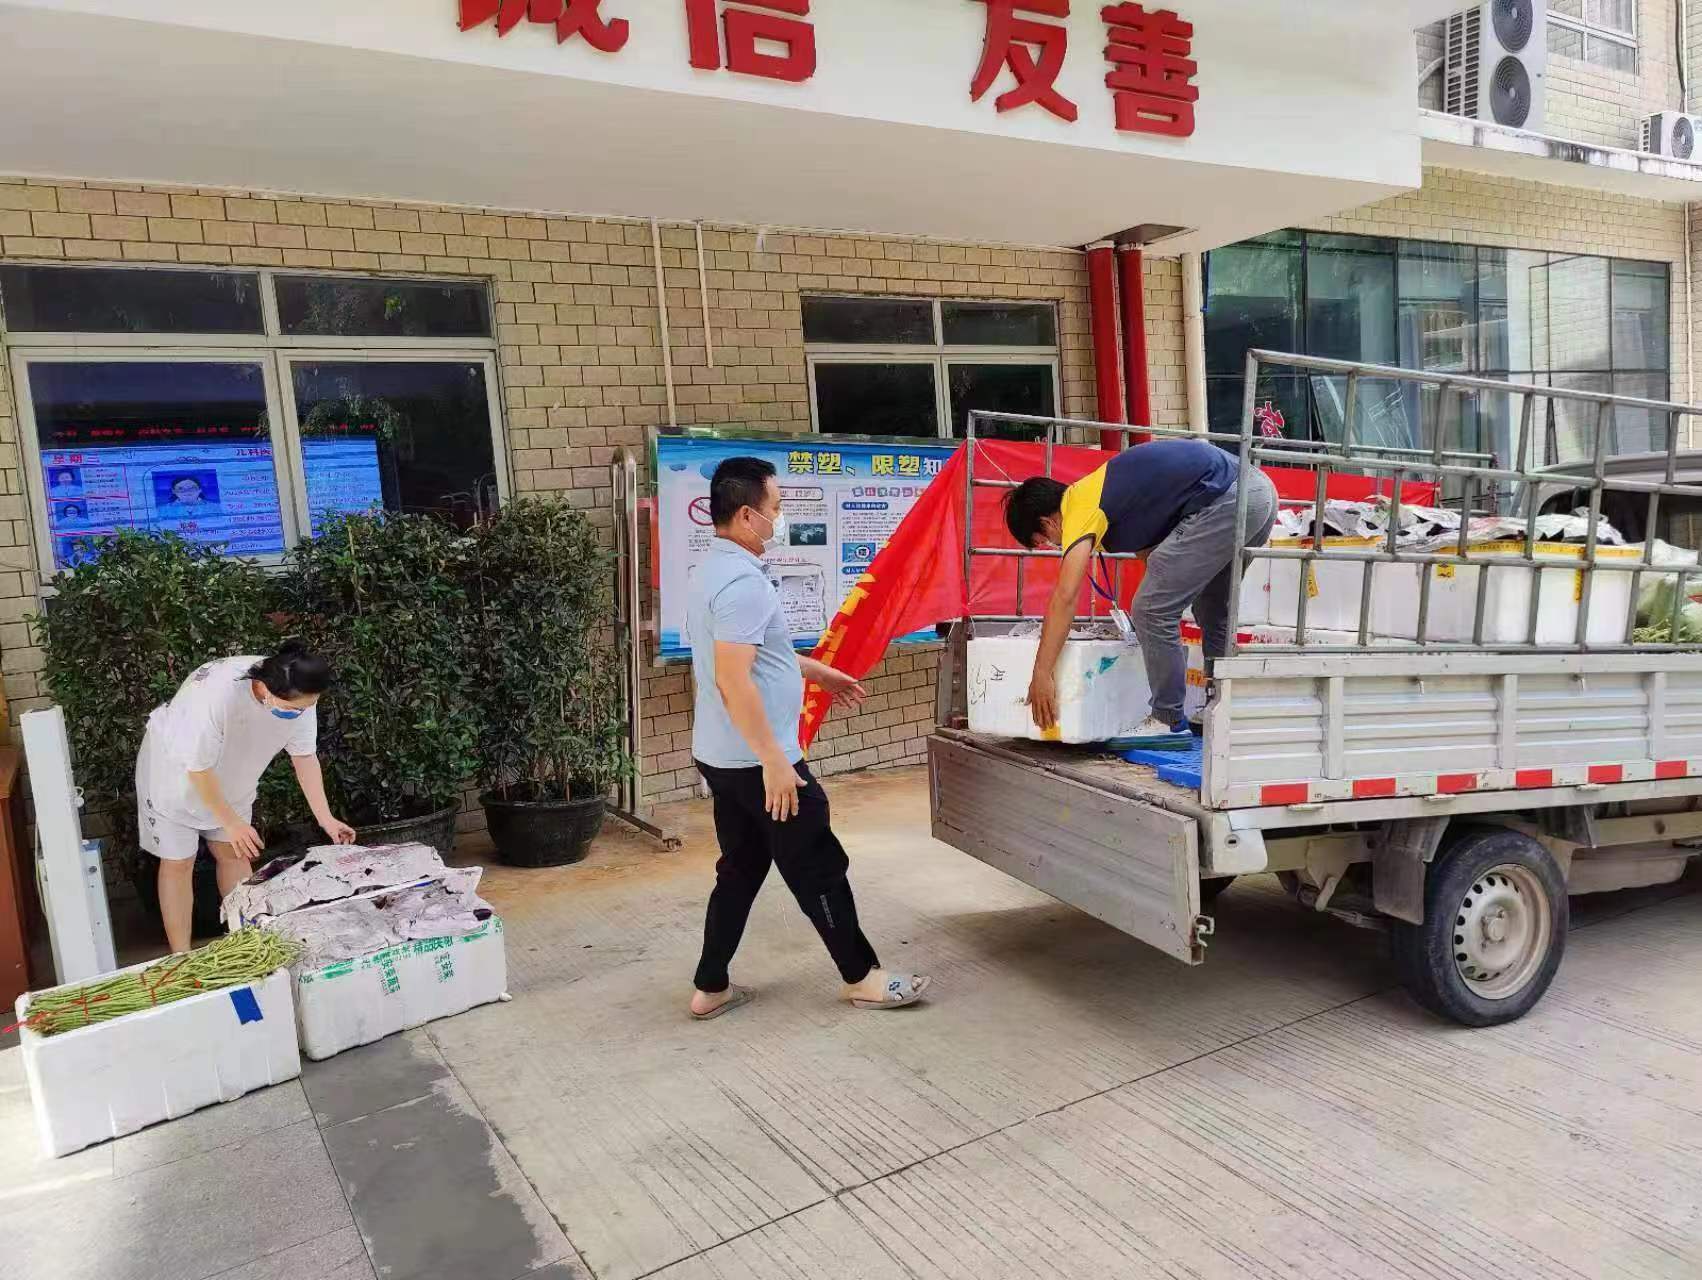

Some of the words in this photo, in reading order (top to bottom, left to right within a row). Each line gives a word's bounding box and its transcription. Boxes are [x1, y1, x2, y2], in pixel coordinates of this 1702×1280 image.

[969, 0, 1199, 137] 友善
[787, 450, 949, 478] 禁塑、限塑知
